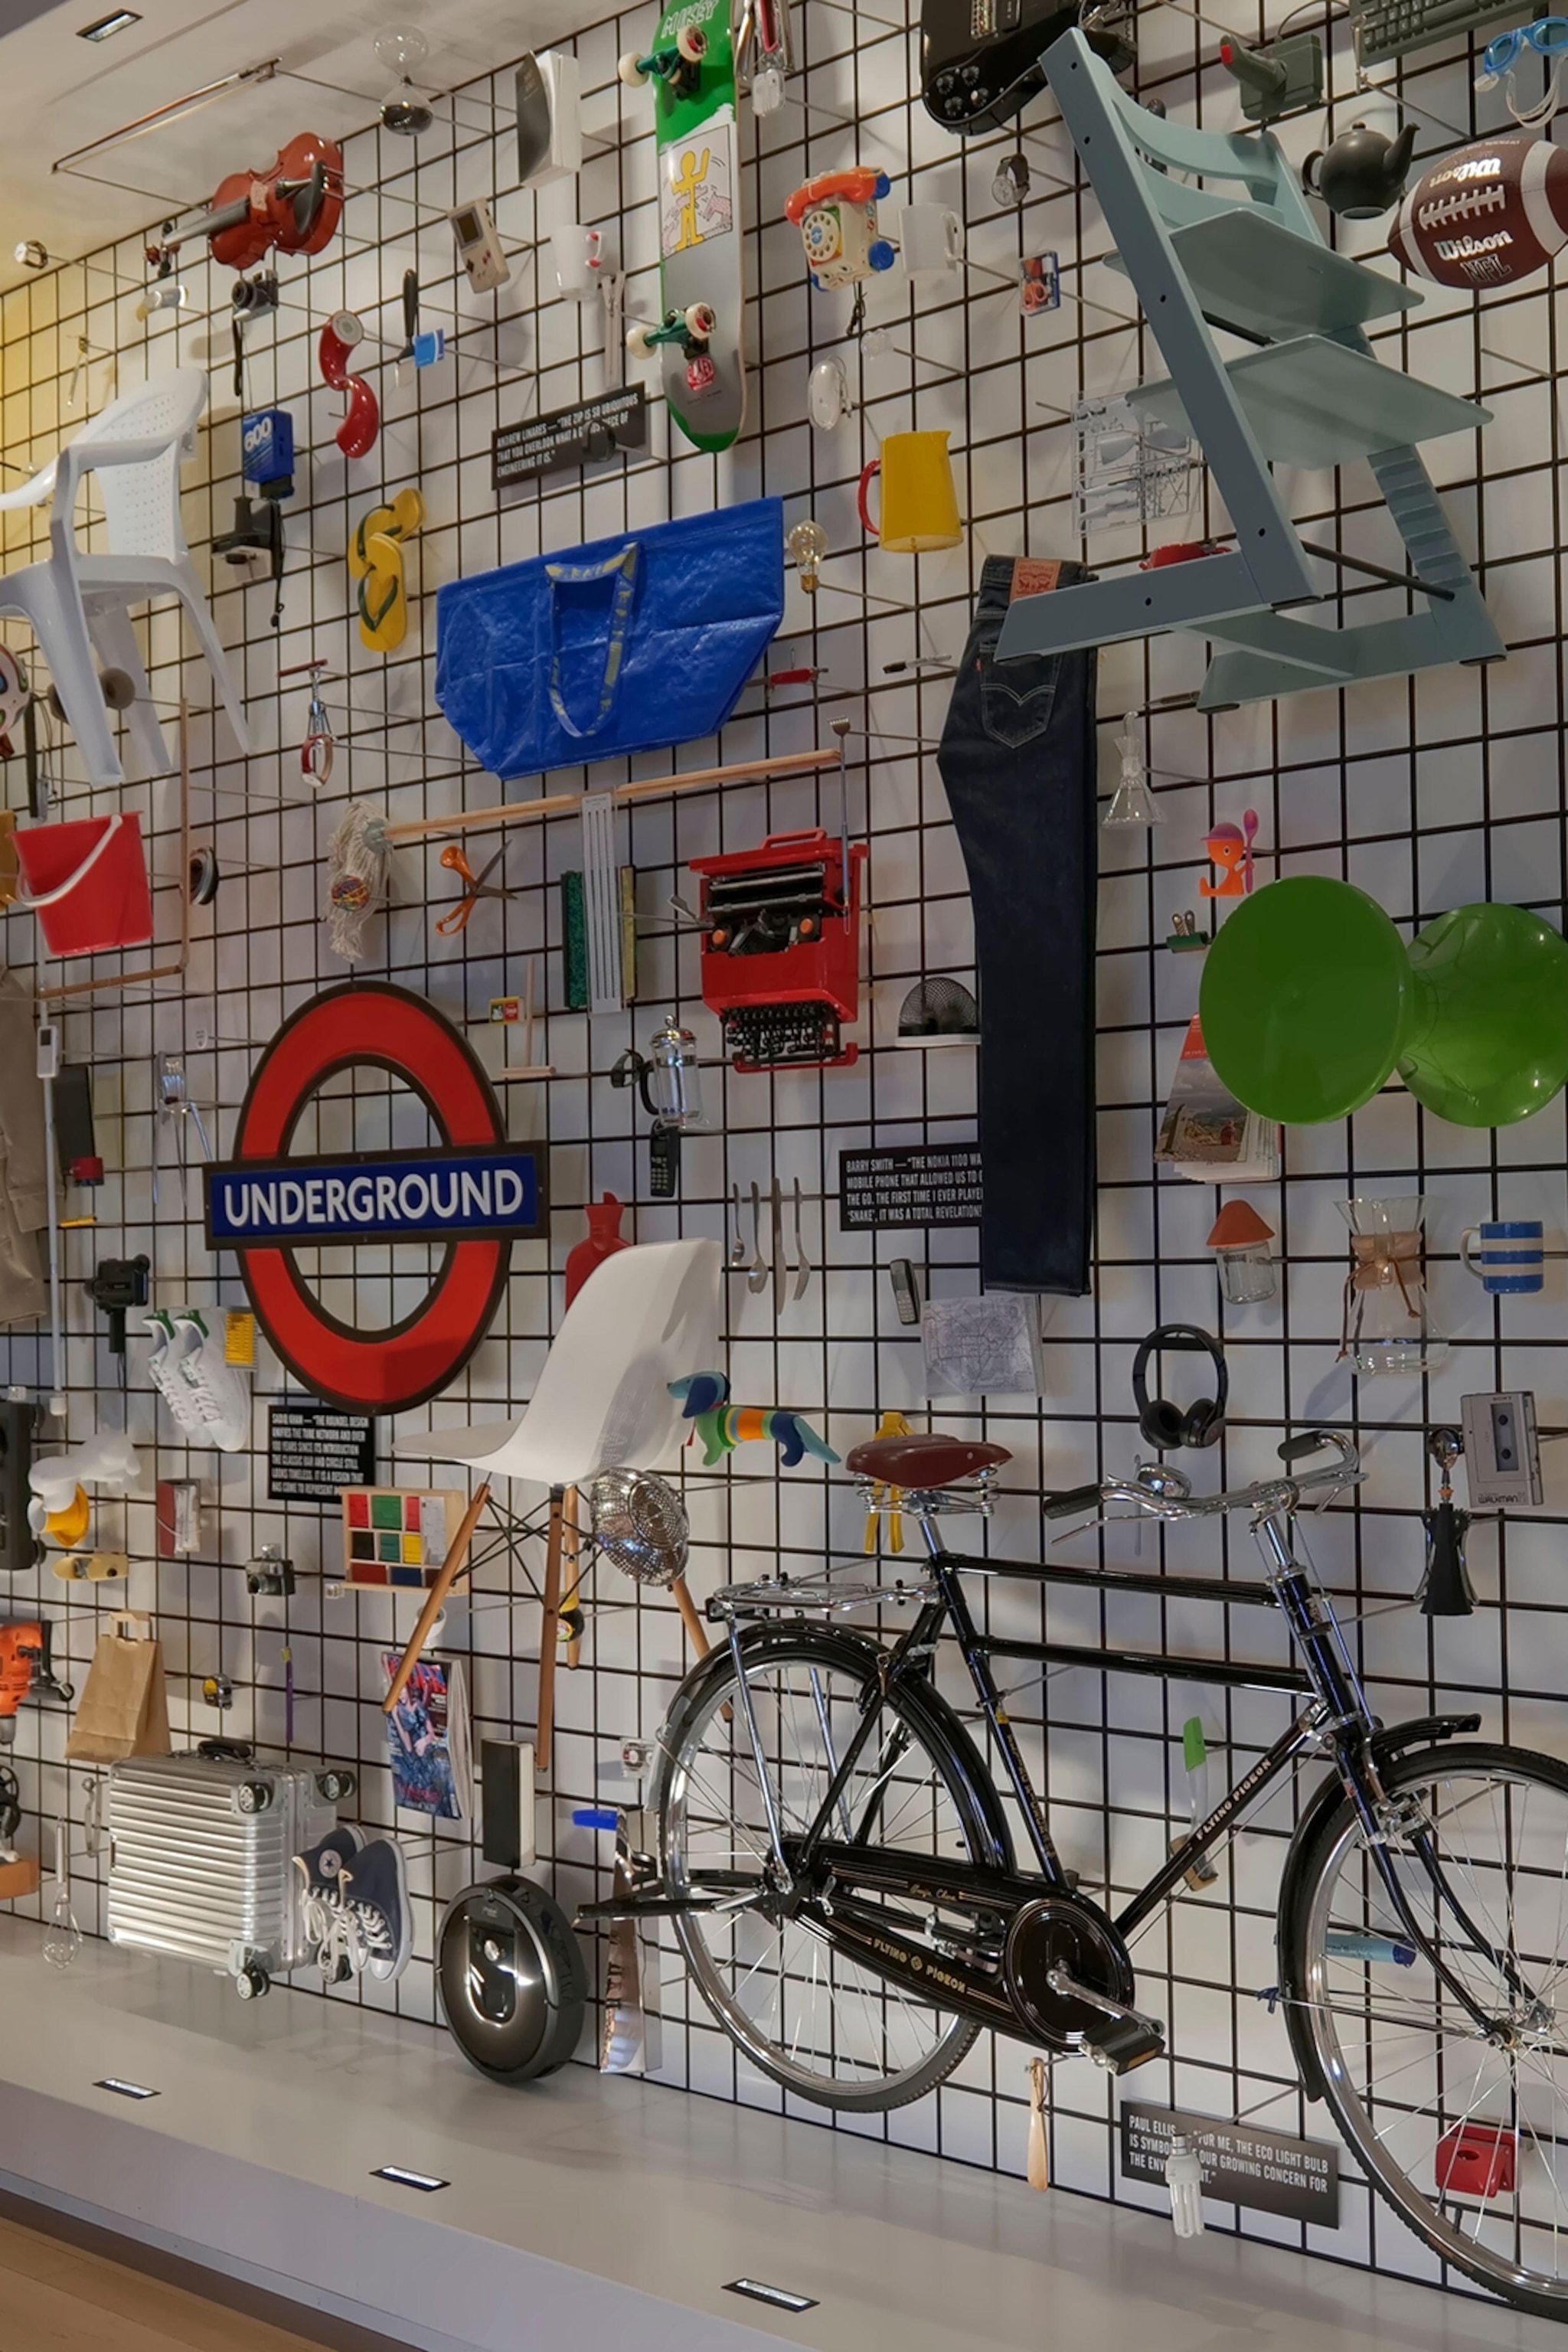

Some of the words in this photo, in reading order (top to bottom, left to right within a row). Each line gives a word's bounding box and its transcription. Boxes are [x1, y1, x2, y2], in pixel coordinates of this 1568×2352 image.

[1429, 157, 1501, 188] Wilson
[1434, 230, 1514, 261] Wilson
[1460, 253, 1513, 283] NFL
[244, 416, 272, 452] 600
[497, 431, 521, 447] ANDREW
[522, 423, 547, 439] LINARES
[573, 410, 583, 423] ZIP
[584, 408, 592, 420] IS
[593, 405, 600, 418] SO
[602, 393, 639, 415] UBIQUITOUS
[497, 449, 511, 463] THAT
[511, 445, 524, 458] YOU
[524, 436, 556, 456] OVERLOOK
[556, 430, 571, 445] WHAT
[573, 427, 579, 439] A
[620, 411, 629, 424] OF
[497, 458, 536, 478] ENGINEERING
[536, 456, 544, 467] IT
[846, 1159, 870, 1172] BARRY
[871, 1158, 894, 1171] SMITH
[926, 1155, 950, 1168] NOKIA
[952, 1154, 969, 1166] 1100
[969, 1153, 982, 1165] WA
[846, 1176, 874, 1189] MOBILE
[874, 1174, 900, 1187] PHONE
[900, 1174, 919, 1186] THAT
[920, 1171, 953, 1186] ALLOWED
[955, 1171, 966, 1184] US
[967, 1170, 978, 1183] TO
[224, 1168, 524, 1227] UNDERGROUND
[846, 1193, 861, 1206] THE
[861, 1192, 874, 1205] GO.
[876, 1191, 890, 1204] THE
[890, 1191, 911, 1204] FIRST
[912, 1190, 930, 1203] TIME
[933, 1190, 936, 1202] I
[937, 1188, 956, 1202] EVER
[879, 1209, 887, 1221] IT
[887, 1208, 904, 1221] WAS
[905, 1207, 913, 1220] A
[913, 1206, 933, 1219] TOTAL
[1478, 1494, 1518, 1504] WALKMAN
[1196, 1801, 1233, 1841] FLYING
[1233, 1759, 1272, 1802] PIGEON
[874, 1938, 908, 1964] FLYING
[926, 1965, 967, 1993] PIGEON
[1129, 2115, 1151, 2132] PAUL
[1152, 2119, 1177, 2137] ELLIS
[1217, 2136, 1234, 2154] ME,
[1236, 2139, 1253, 2156] THE
[1255, 2144, 1272, 2161] ECO
[1275, 2148, 1302, 2168] LIGHT
[1304, 2155, 1328, 2174] BULB
[1129, 2151, 1146, 2167] THE
[1129, 2134, 1138, 2148] IS
[1199, 2151, 1217, 2167] OUR
[1220, 2154, 1262, 2177] GROWING
[1263, 2165, 1306, 2188] CONCERN
[1309, 2176, 1328, 2194] FOR
